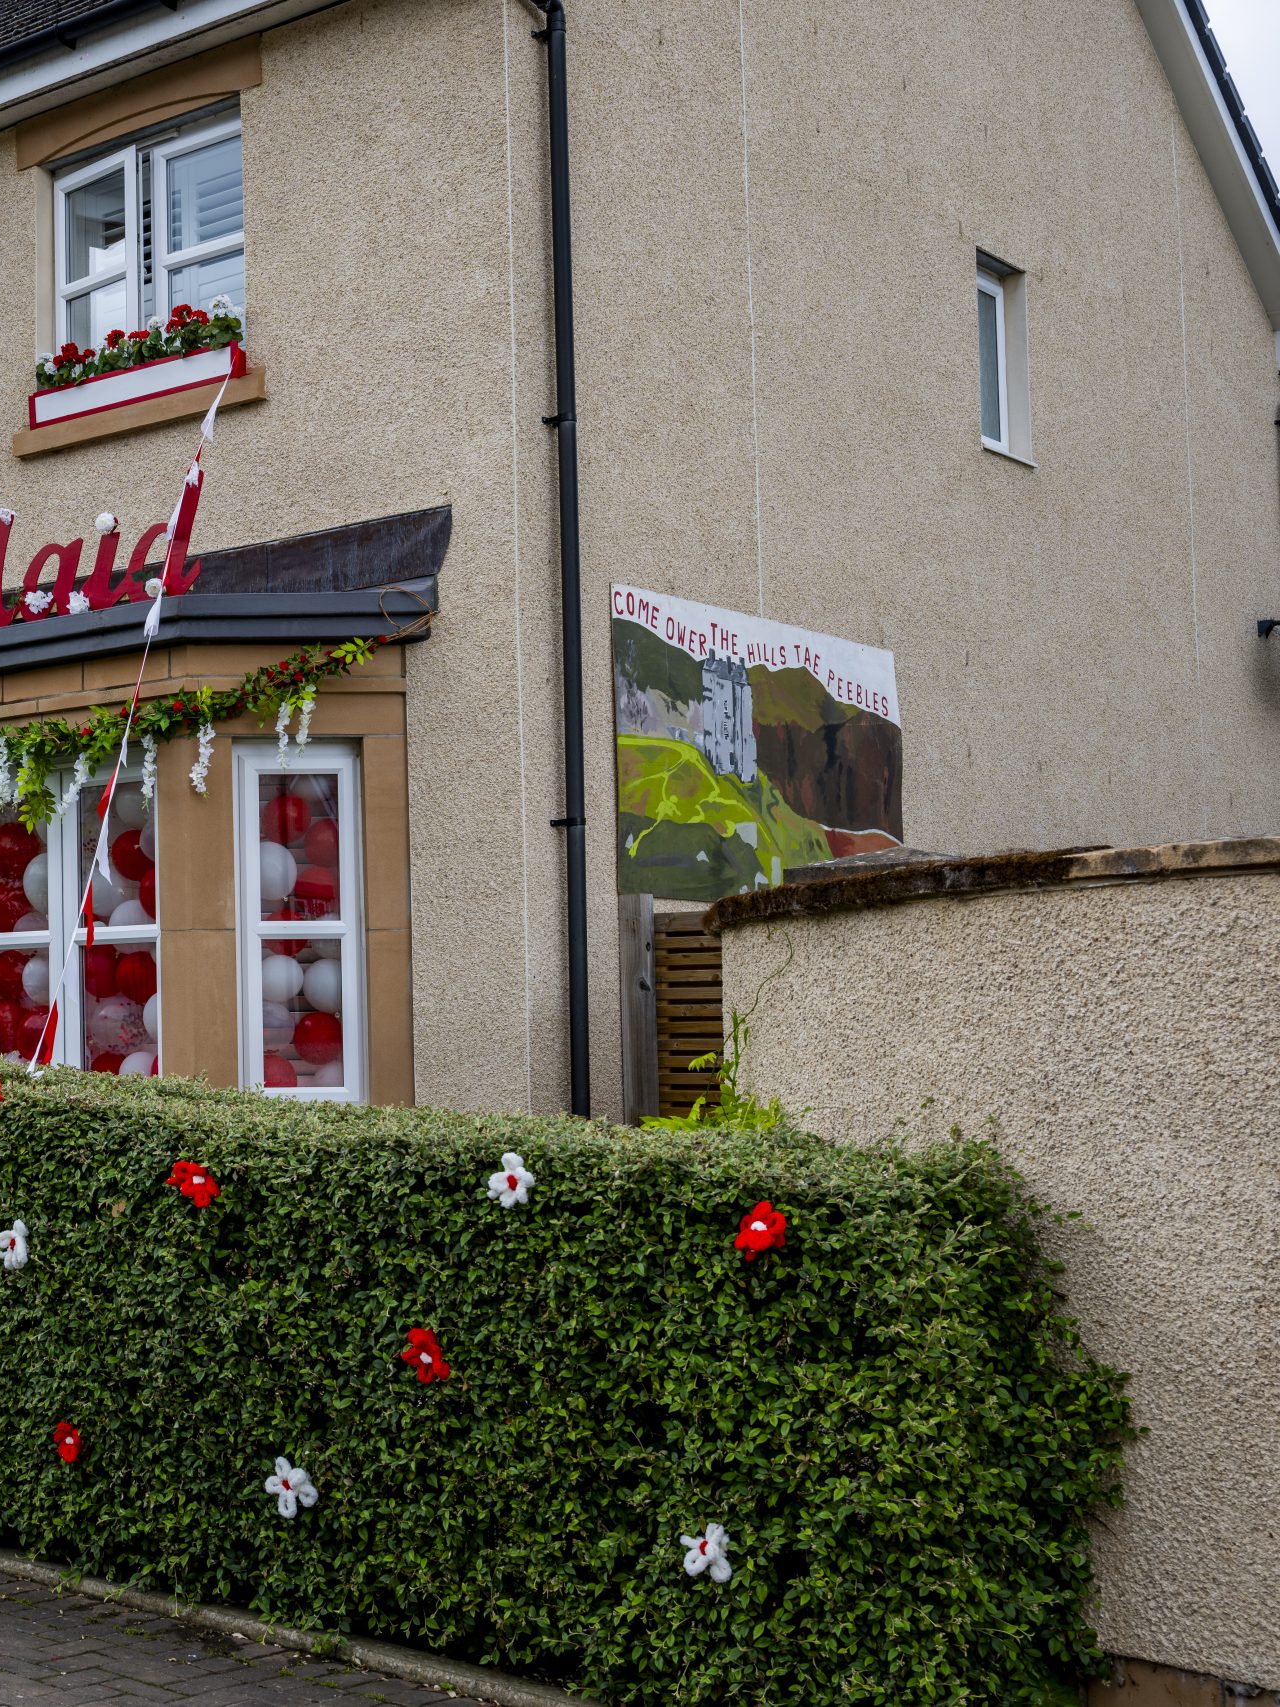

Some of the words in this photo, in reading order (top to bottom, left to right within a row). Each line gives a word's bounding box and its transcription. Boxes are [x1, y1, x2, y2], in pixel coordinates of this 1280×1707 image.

[613, 591, 659, 629] COME
[666, 617, 707, 656] OWER
[711, 622, 738, 655] THE
[747, 643, 786, 666] HILLS
[794, 645, 820, 675] TAE
[827, 669, 888, 716] PEEBLES
